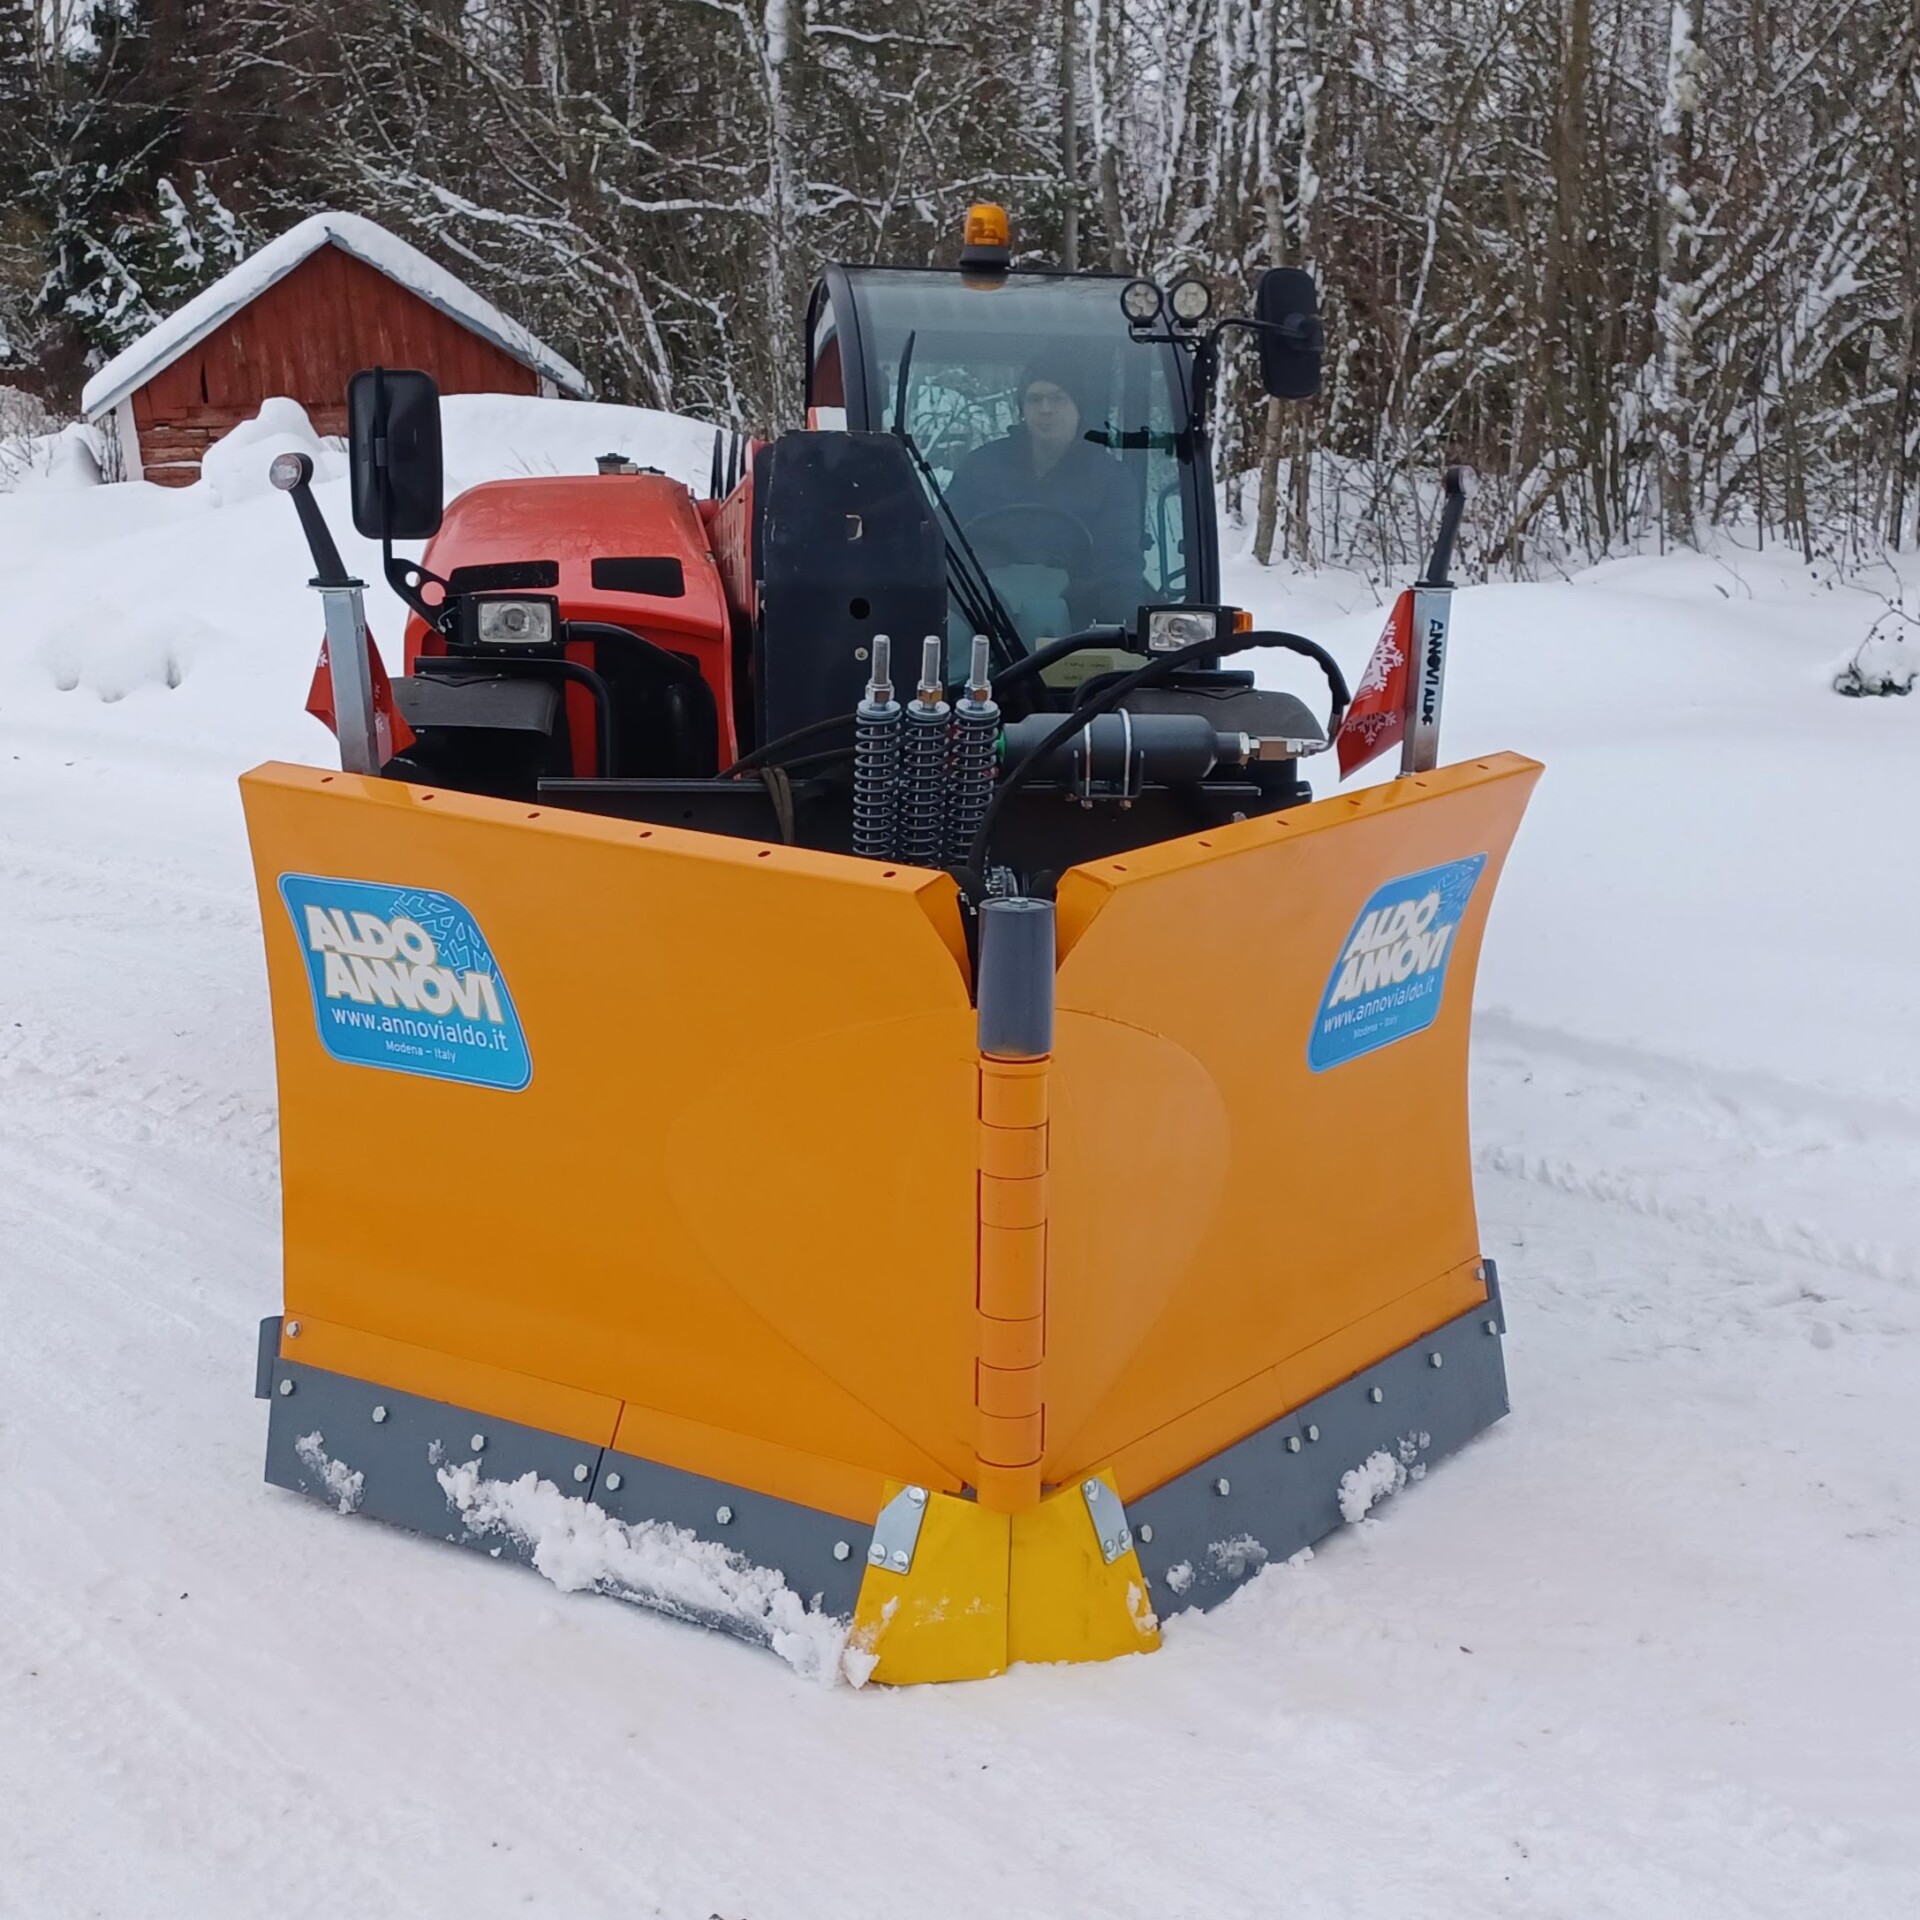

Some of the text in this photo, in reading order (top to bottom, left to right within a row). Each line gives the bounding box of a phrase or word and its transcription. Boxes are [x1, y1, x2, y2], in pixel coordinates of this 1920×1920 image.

[1425, 619, 1444, 685] ANNOVI
[304, 904, 437, 967] ALDO
[1343, 892, 1442, 961] ALDO
[323, 951, 504, 1023] ANNOVI
[1327, 924, 1453, 1009] ANNOVI
[331, 1007, 509, 1051] www.annovialdo.it
[1323, 975, 1436, 1034] www.annovialdo.it
[385, 1040, 424, 1056] Modena
[434, 1047, 456, 1063] Italy
